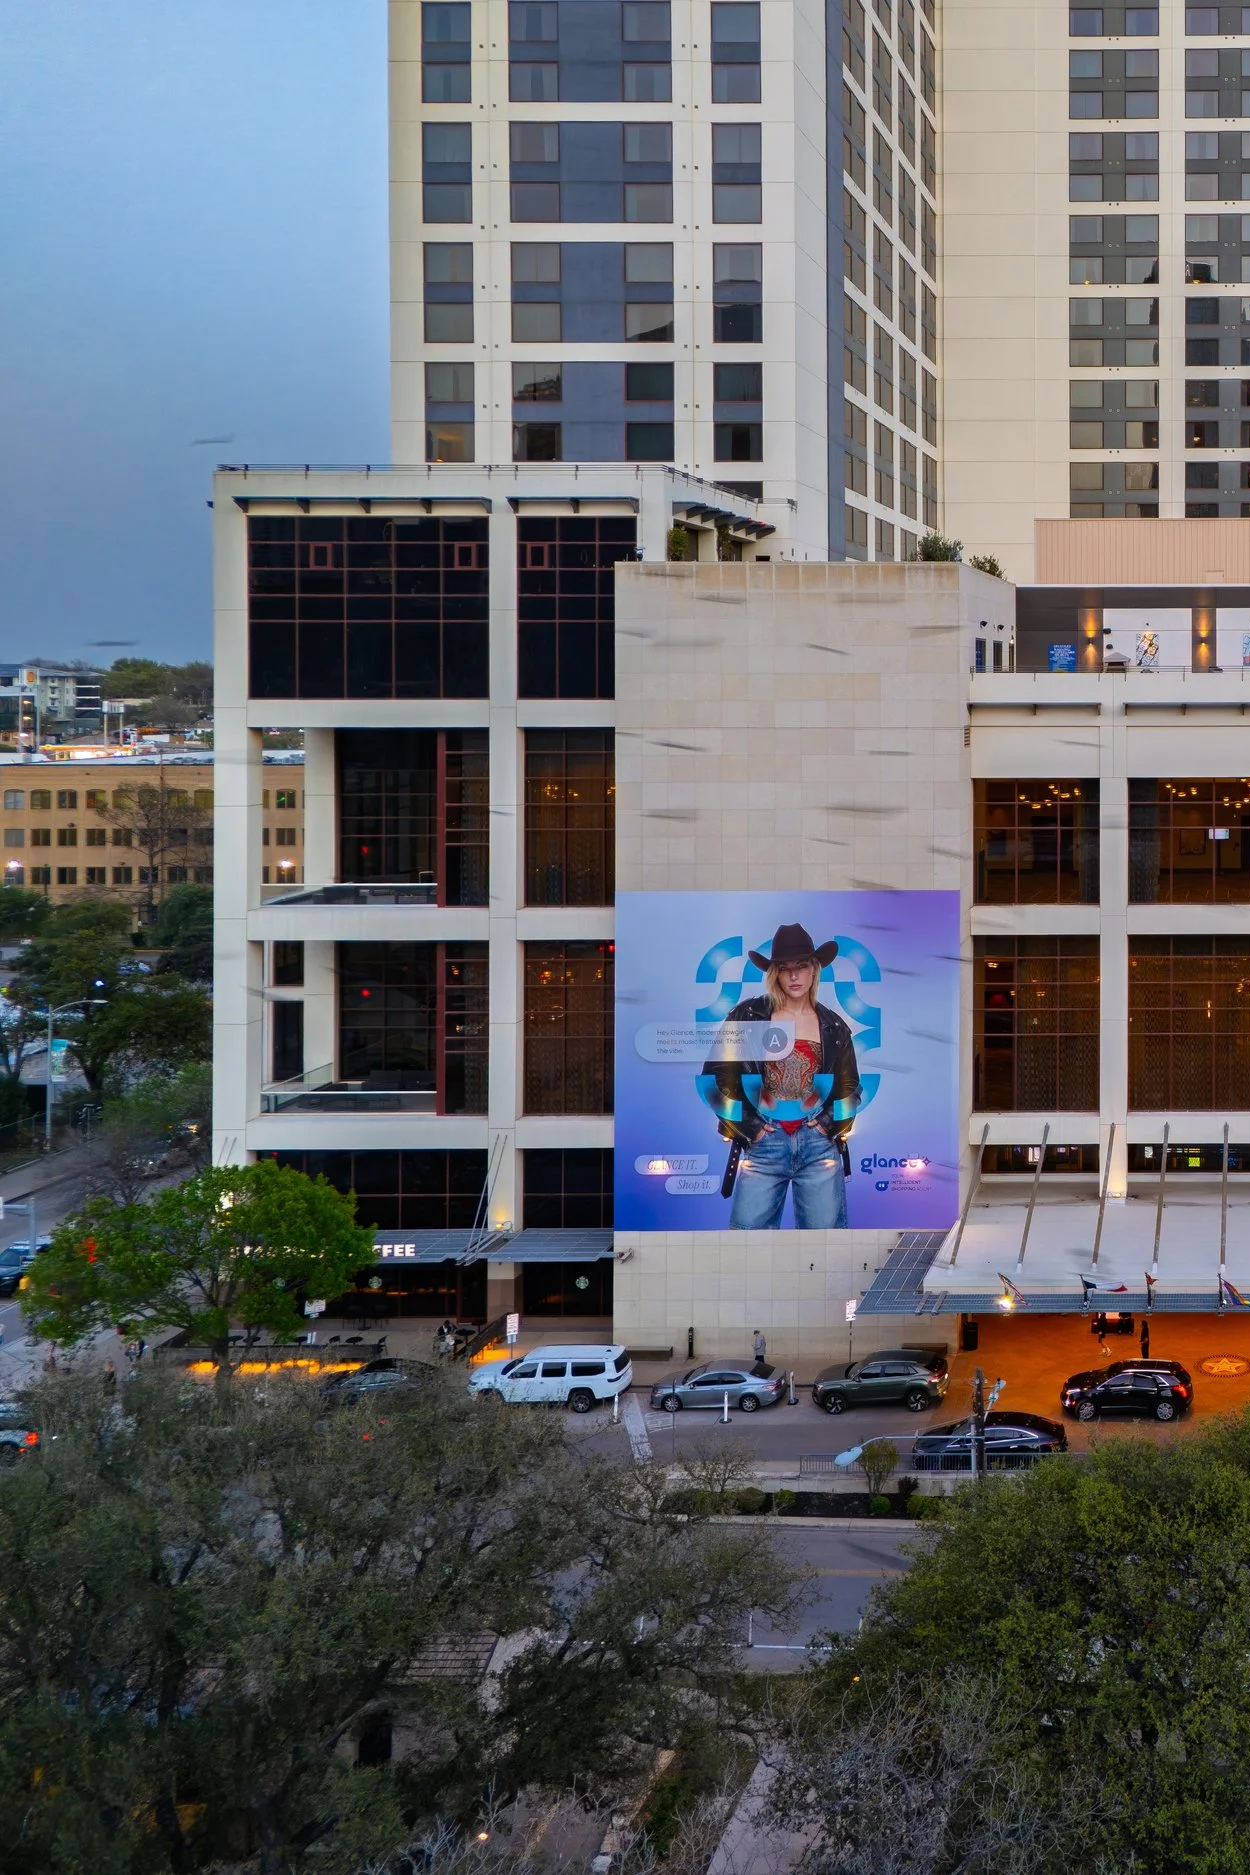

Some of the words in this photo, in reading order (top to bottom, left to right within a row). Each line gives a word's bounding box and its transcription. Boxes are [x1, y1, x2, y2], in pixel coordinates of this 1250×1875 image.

[769, 1034, 781, 1047] A
[860, 1153, 918, 1174] glance
[677, 1179, 700, 1192] Shop
